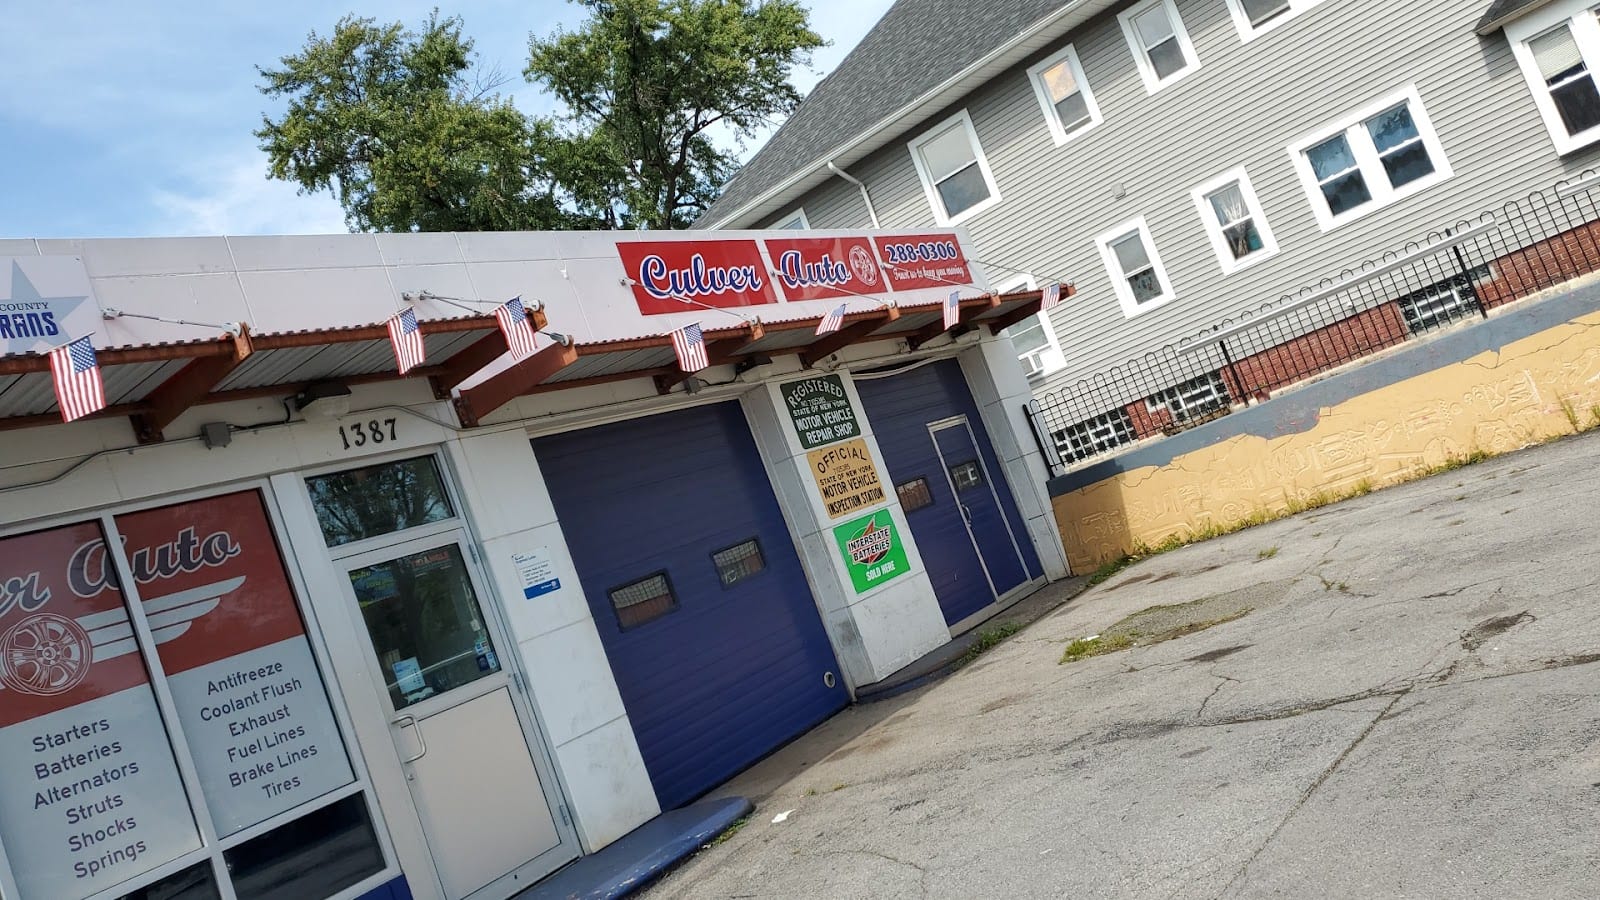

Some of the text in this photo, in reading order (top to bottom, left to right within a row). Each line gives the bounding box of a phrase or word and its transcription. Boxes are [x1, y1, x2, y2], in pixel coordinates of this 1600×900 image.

[640, 250, 852, 299] Culver Auto
[0, 302, 48, 311] COUNTY
[787, 380, 843, 408] REGISTERED
[793, 408, 811, 416] STATE
[832, 400, 847, 408] YORK
[339, 417, 397, 450] 1387
[796, 408, 853, 432] MOTOR VEHICLE
[806, 422, 853, 444] REPAIR SHOP
[817, 447, 867, 474] OFFICIAL
[820, 476, 837, 486] STATE
[846, 469, 857, 478] NEW
[858, 465, 872, 473] YORK
[822, 472, 878, 499] MOTOR VEHICLE
[827, 487, 884, 516] INSPECTION STATION
[848, 529, 889, 551] INTERSTATE
[853, 540, 889, 562] BATTERIES
[67, 526, 242, 599] Auto
[865, 560, 896, 581] SOLD HERE
[207, 662, 283, 696] Antifreeze
[200, 677, 302, 721] Coolant Flush
[32, 719, 110, 752] Starters
[228, 704, 291, 737] Exhaust
[227, 725, 305, 763] Fuel Lines
[34, 741, 122, 780] Batteries
[229, 745, 318, 788] Brake Lines
[34, 762, 140, 810] Alternators
[261, 776, 301, 799] Tires
[66, 794, 124, 825] Struts
[68, 817, 137, 852] Shocks
[74, 840, 147, 879] Springs
